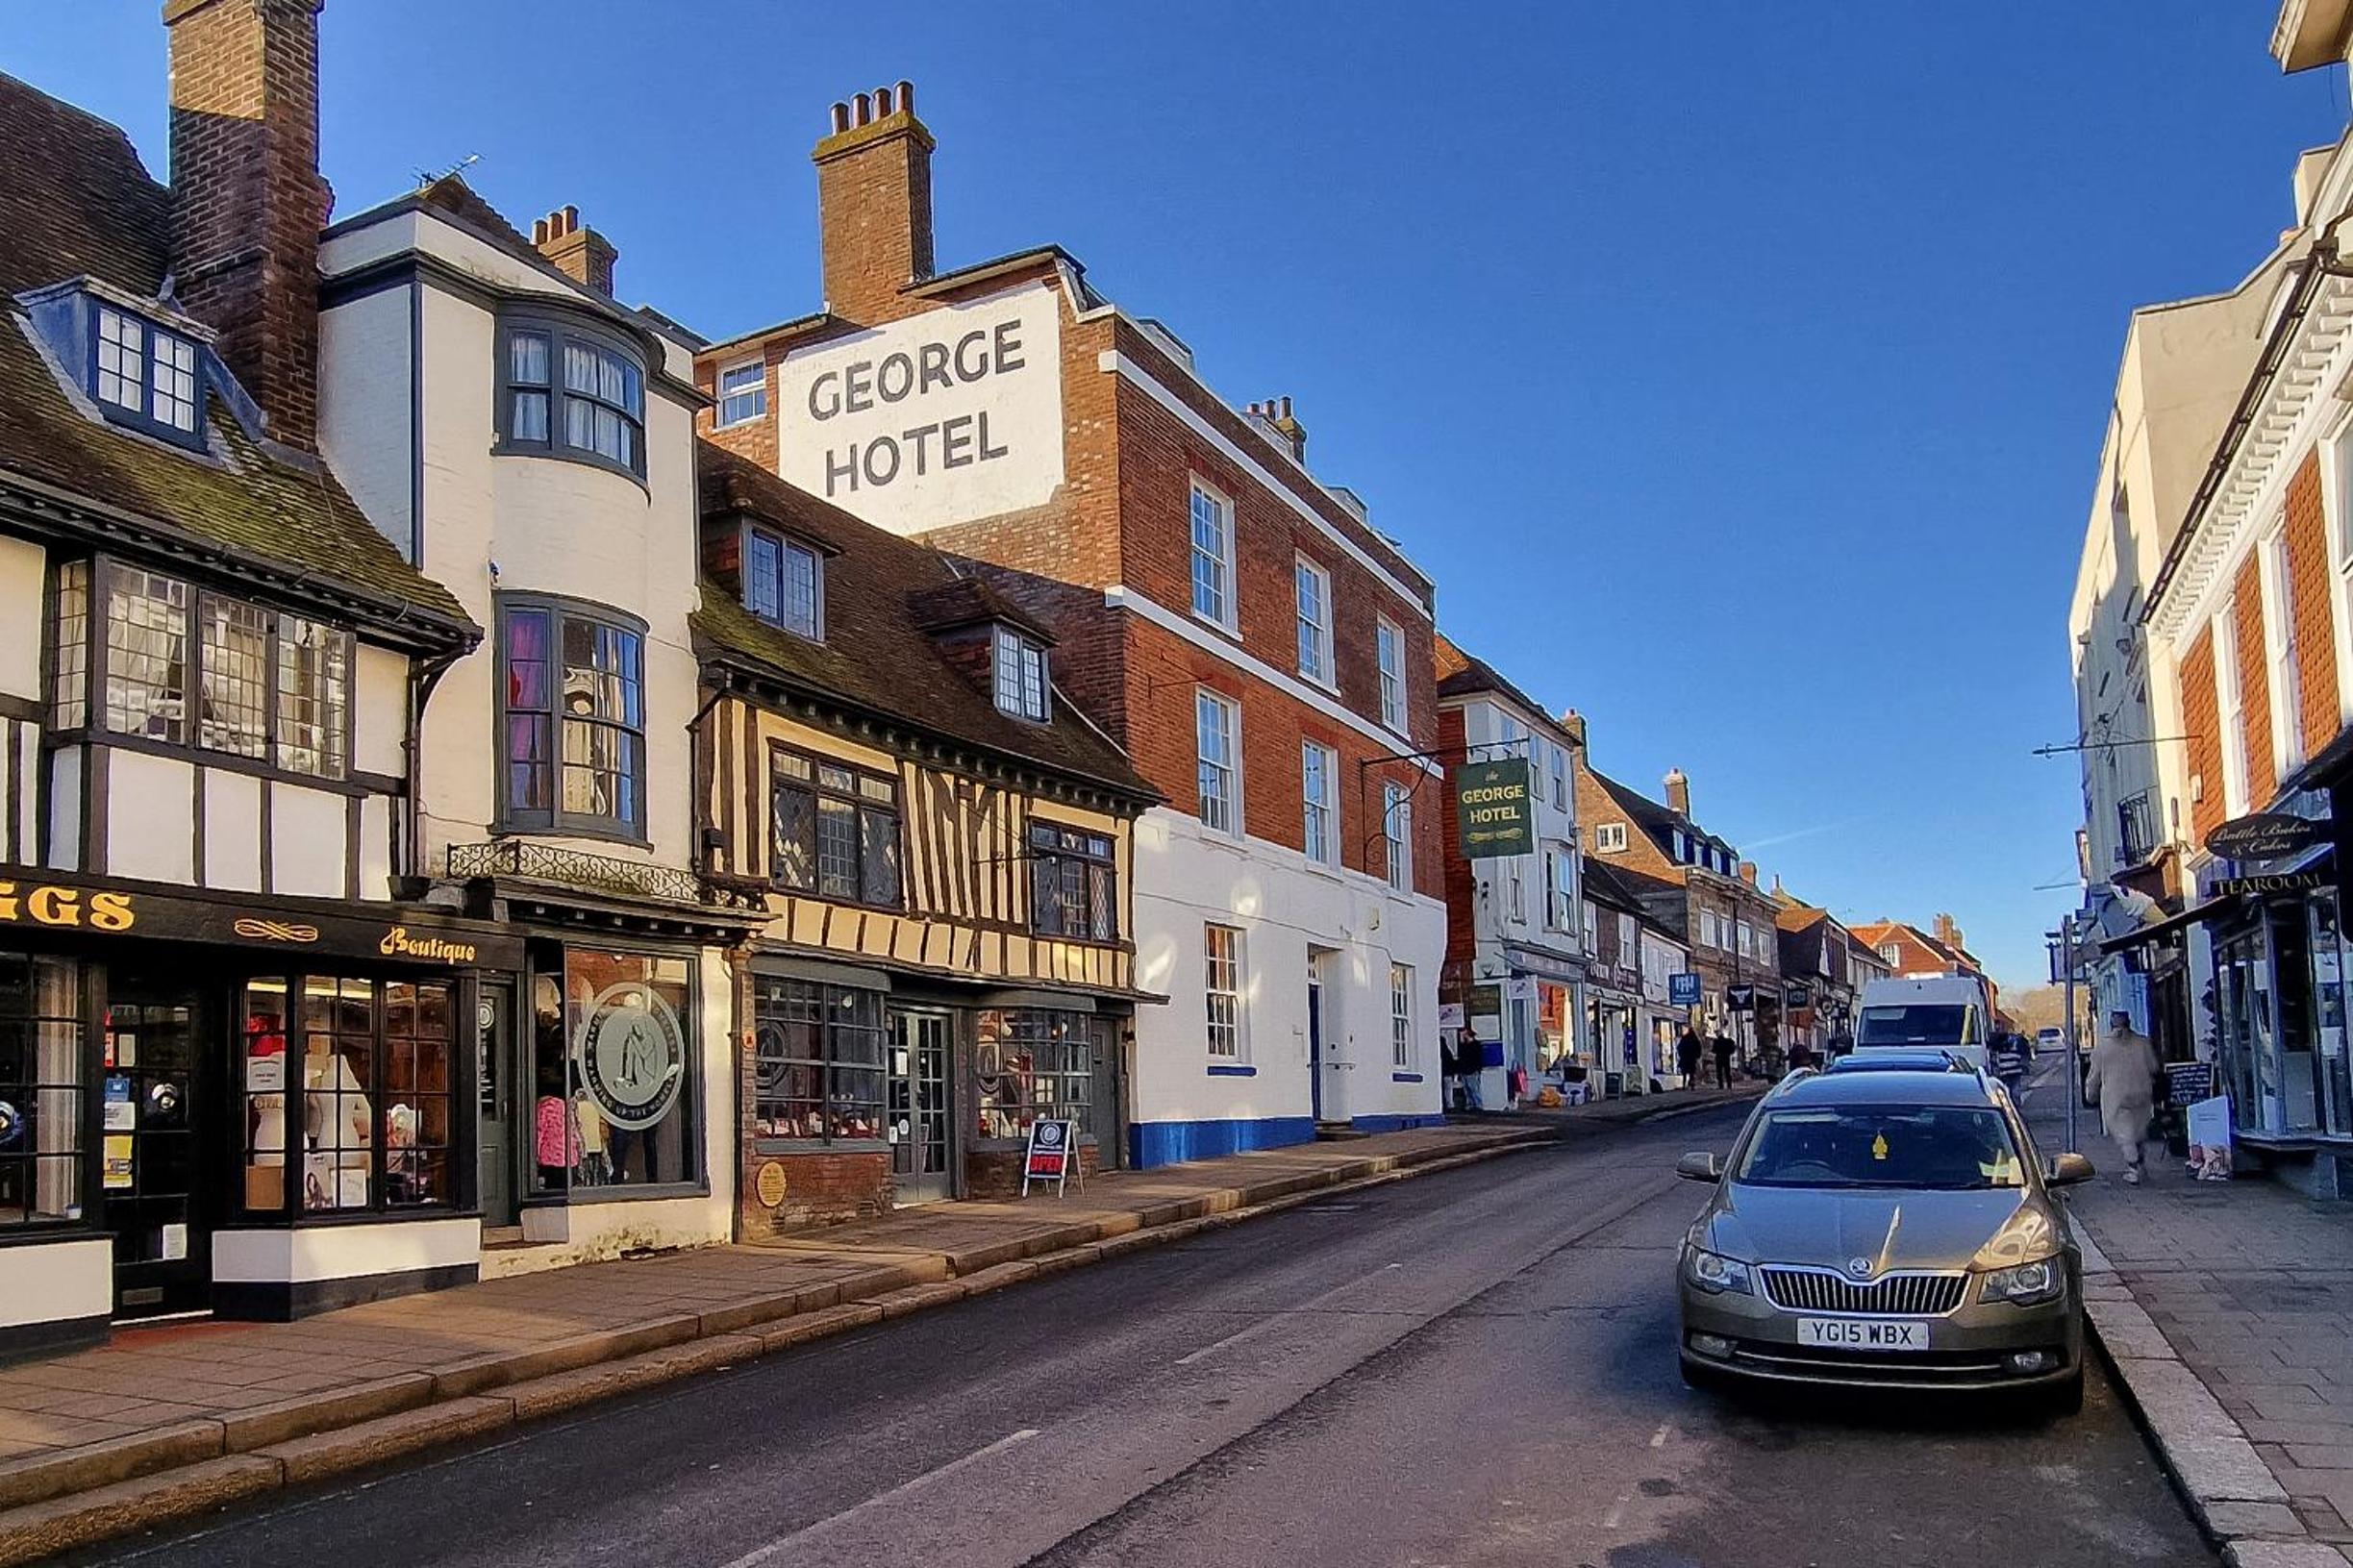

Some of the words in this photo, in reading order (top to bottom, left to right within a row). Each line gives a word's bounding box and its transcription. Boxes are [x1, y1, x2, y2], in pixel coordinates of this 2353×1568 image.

[809, 319, 1025, 421] GEORGE
[826, 411, 1008, 497] HOTEL
[1462, 784, 1524, 804] GEORGE
[1469, 806, 1520, 823] HOTEL
[2216, 872, 2320, 895] TEAROOM
[380, 927, 476, 965] Boutique
[1813, 1322, 1862, 1343] YG15
[1868, 1325, 1913, 1345] WBX
